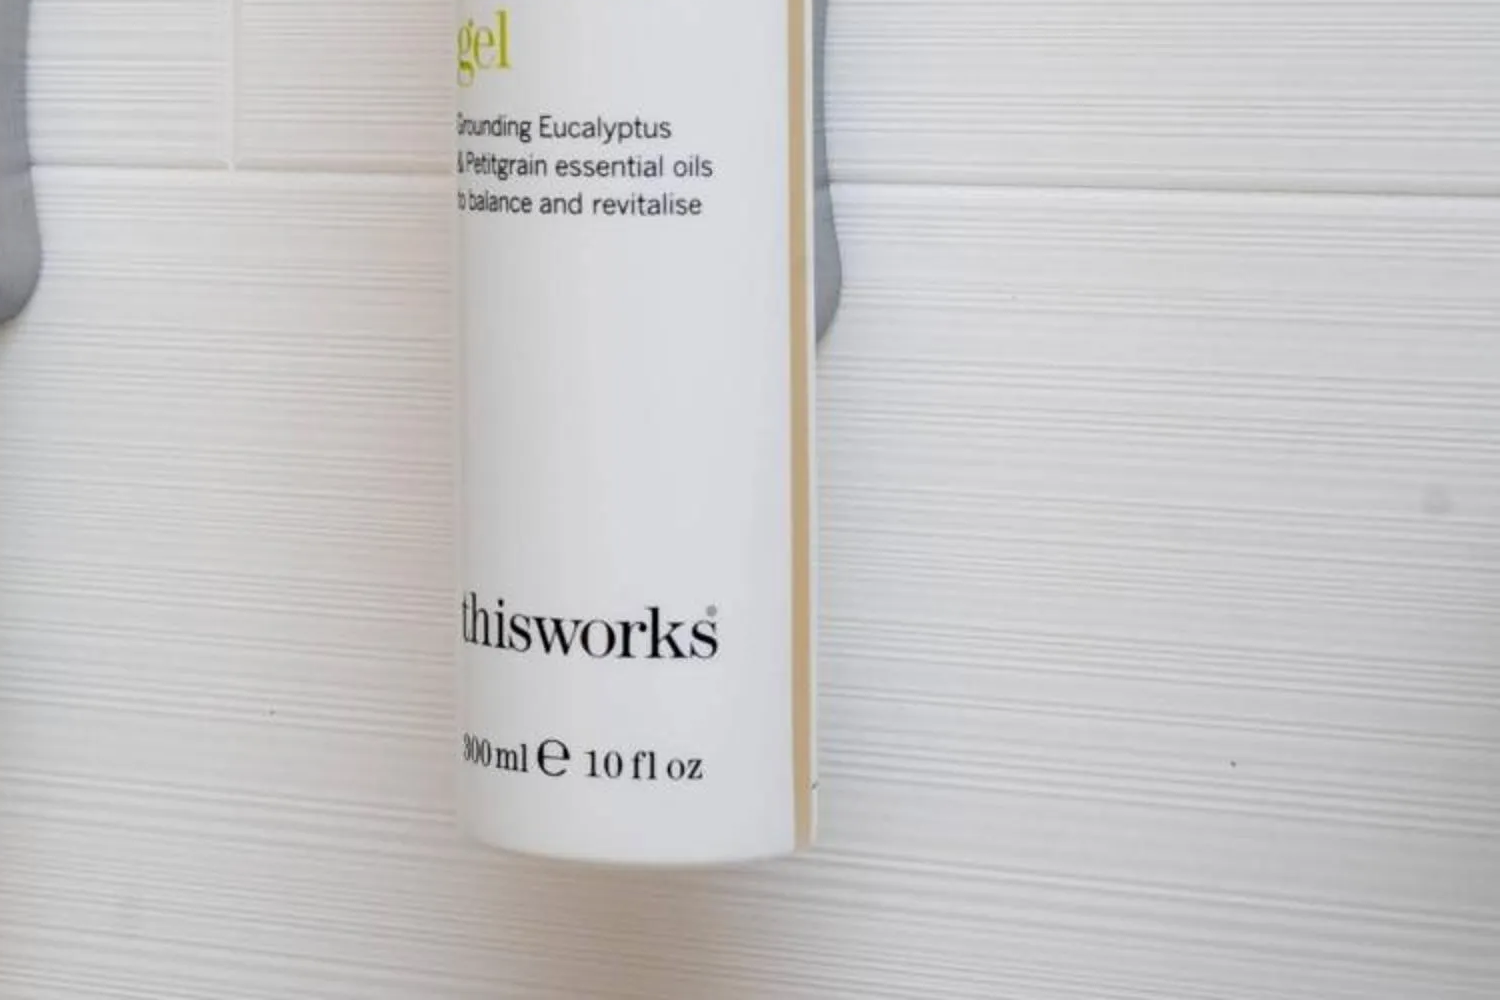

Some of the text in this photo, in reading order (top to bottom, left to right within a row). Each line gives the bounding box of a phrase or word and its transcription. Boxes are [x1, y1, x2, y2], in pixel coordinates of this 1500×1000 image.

[457, 10, 510, 88] gel
[539, 114, 672, 144] Eucalyptus
[466, 152, 547, 180] Petitgrain
[555, 154, 663, 178] essential
[673, 155, 713, 178] oils
[469, 190, 532, 213] balance
[539, 193, 583, 215] and
[592, 193, 703, 216] revitalise
[585, 750, 623, 778] 10
[632, 751, 656, 780] fl
[667, 758, 704, 780] oz
